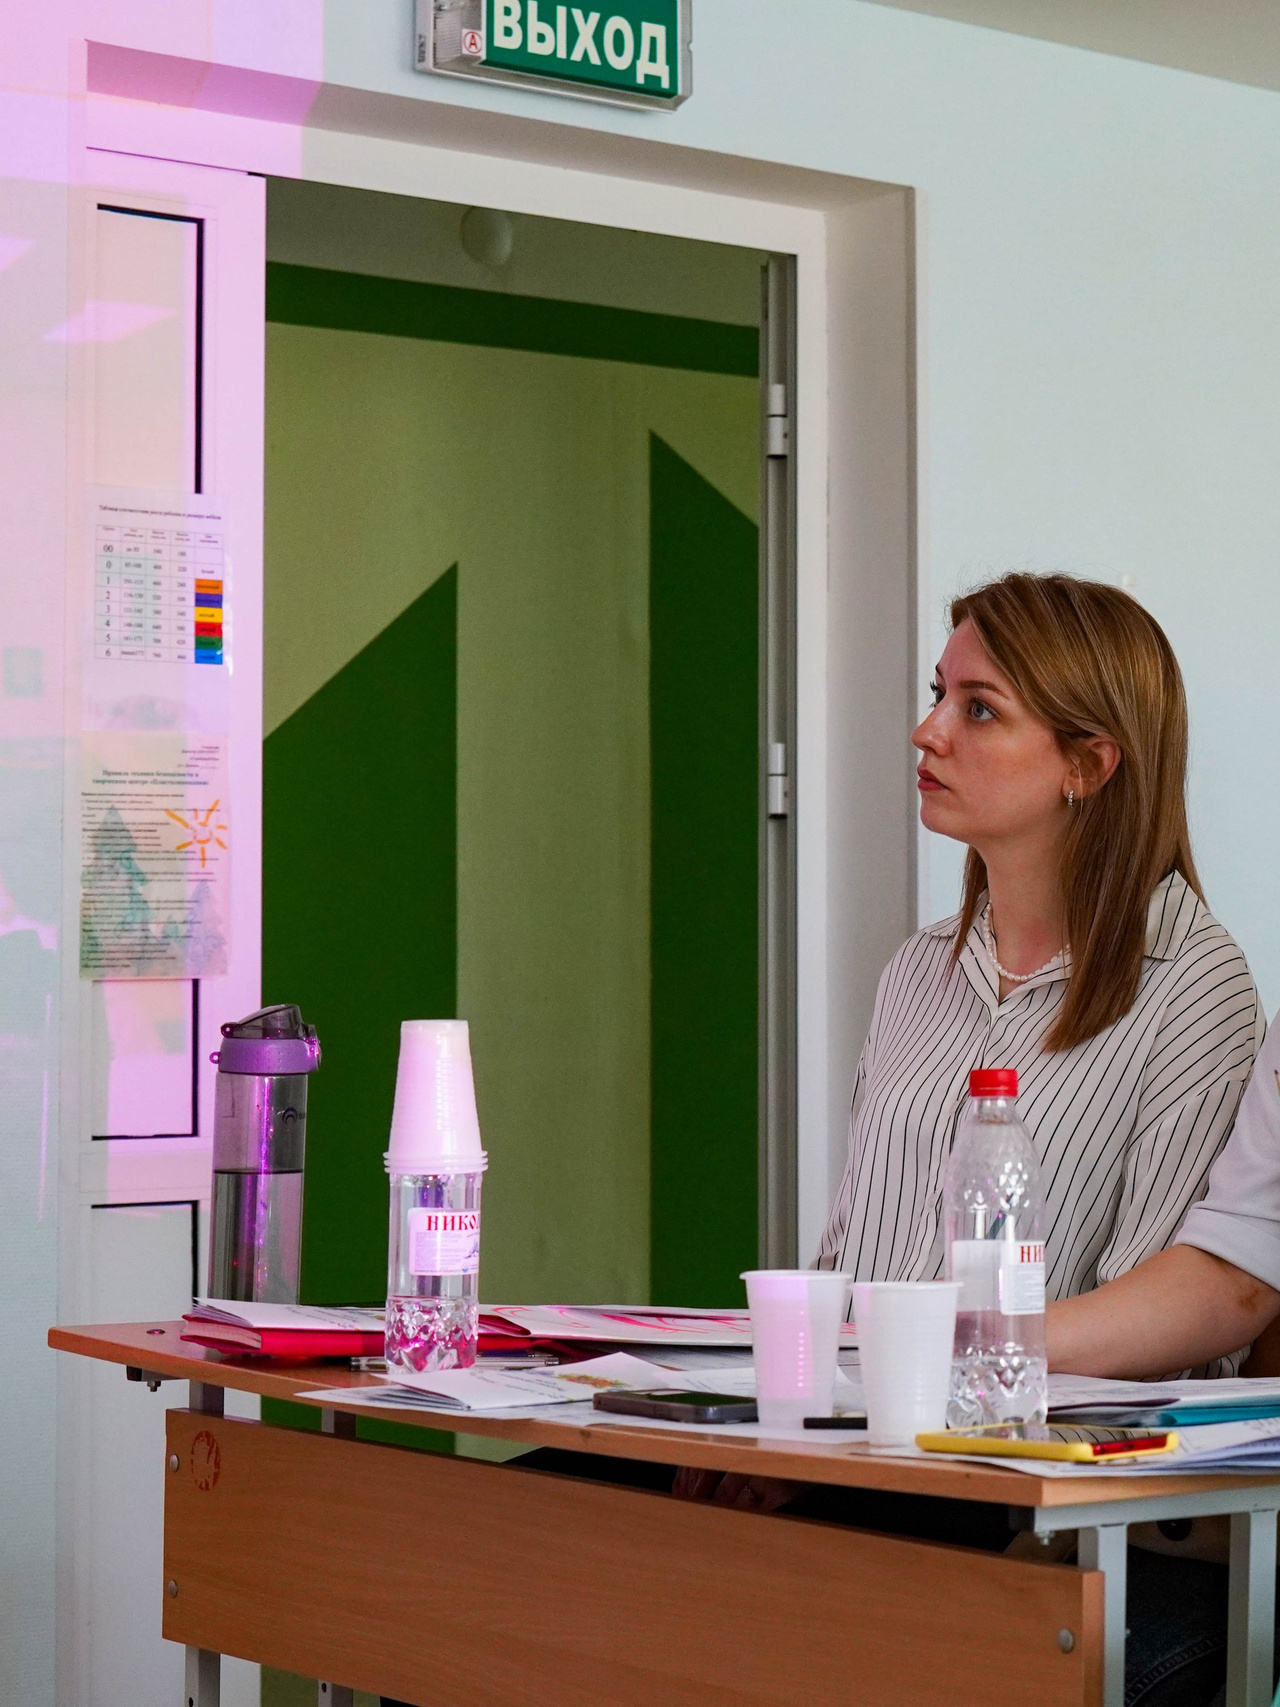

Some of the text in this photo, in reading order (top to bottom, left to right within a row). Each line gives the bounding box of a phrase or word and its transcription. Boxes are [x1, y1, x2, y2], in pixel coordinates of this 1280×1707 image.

[494, 0, 670, 89] ВЫХОД
[105, 590, 111, 600] 2
[106, 633, 111, 642] 5
[105, 648, 111, 657] 6
